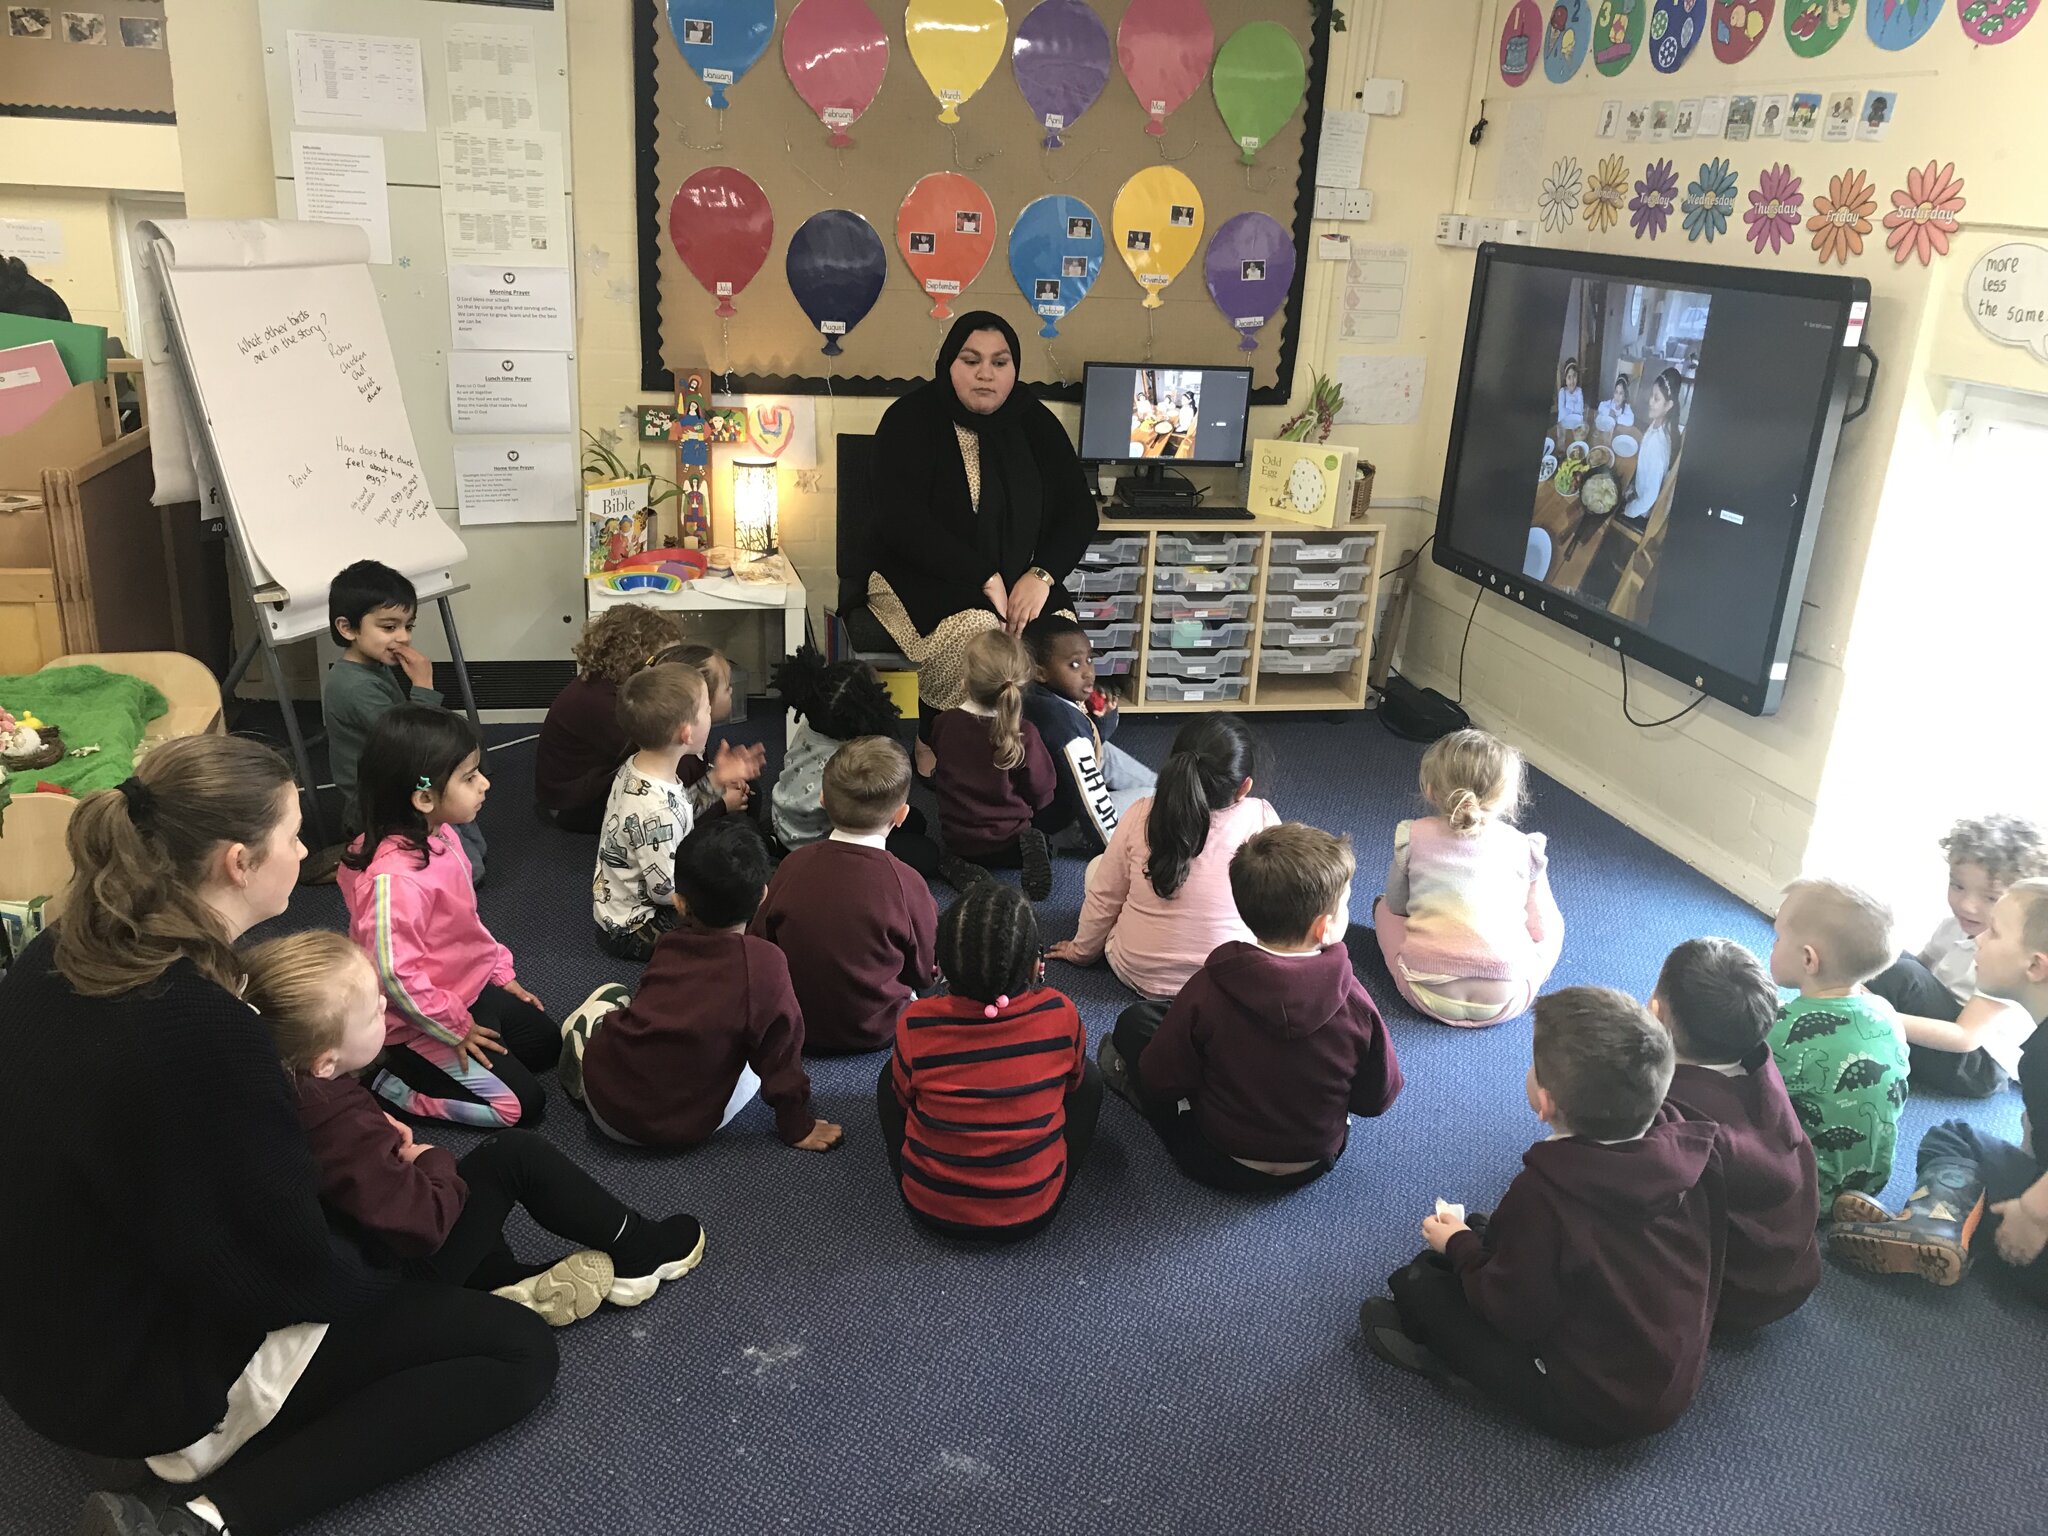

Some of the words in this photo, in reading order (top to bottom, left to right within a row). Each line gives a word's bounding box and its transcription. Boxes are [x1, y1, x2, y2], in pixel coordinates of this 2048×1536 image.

[1571, 2, 1580, 22] 2
[1600, 0, 1612, 28] 3
[704, 70, 732, 83] January
[940, 90, 960, 99] March
[1152, 101, 1164, 112] May
[824, 110, 852, 122] February
[1047, 115, 1063, 126] April
[1640, 192, 1670, 208] Tuesday
[1687, 193, 1735, 210] Wednesday
[1754, 202, 1798, 218] Thursday
[1826, 210, 1860, 226] Friday
[1896, 204, 1955, 224] Saturday
[1986, 257, 2019, 273] more
[927, 280, 959, 292] September
[1140, 275, 1168, 284] November
[1982, 276, 2007, 292] less
[718, 284, 731, 295] July
[1039, 306, 1064, 315] October
[1978, 298, 1998, 317] the
[822, 323, 845, 333] August
[1236, 318, 1263, 327] December
[237, 333, 262, 356] What
[264, 322, 287, 342] other
[287, 309, 310, 326] birds
[254, 350, 268, 364] are
[270, 344, 280, 355] in
[281, 334, 298, 349] the
[298, 312, 331, 342] story?
[327, 342, 353, 359] Robin
[339, 352, 367, 374] Chicken
[352, 364, 366, 381] Owl
[366, 385, 382, 403] duck
[335, 435, 355, 453] How
[359, 444, 378, 457] does
[379, 448, 393, 461] the
[397, 455, 414, 468] duck
[345, 458, 365, 469] feel
[370, 463, 388, 474] about
[1262, 455, 1282, 467] Odd
[288, 463, 313, 489] Proud
[1262, 466, 1278, 478] Egg
[366, 474, 387, 487] egg?
[610, 488, 628, 496] Baby
[603, 497, 635, 514] Bible
[212, 522, 223, 531] 40
